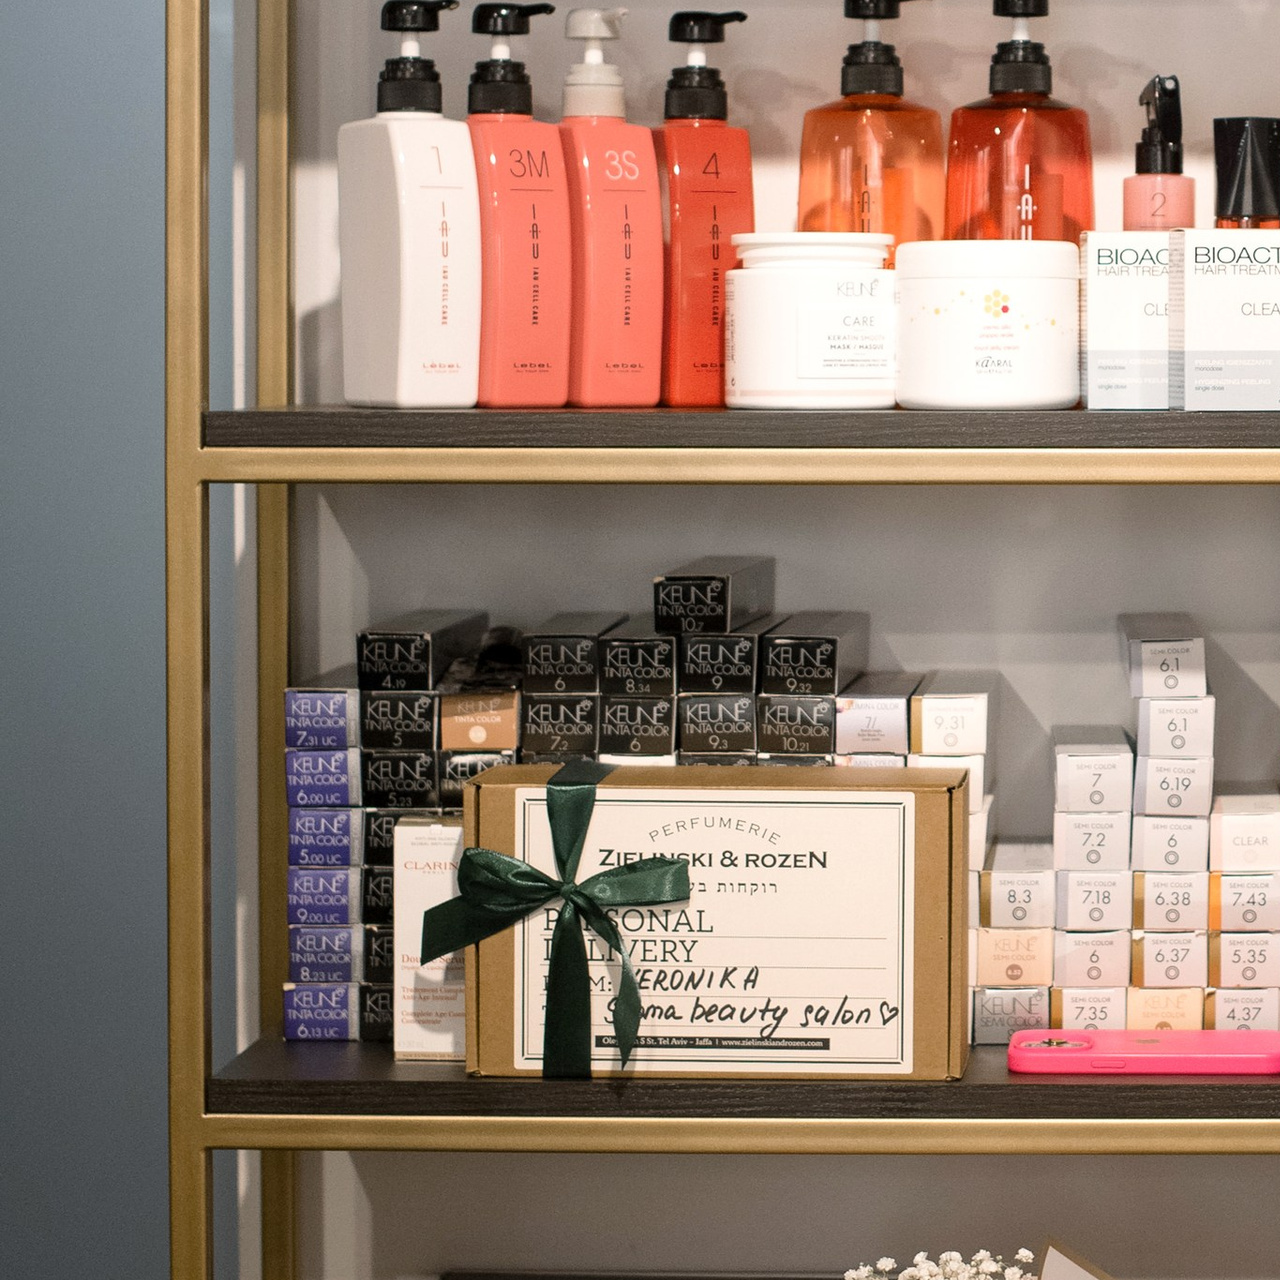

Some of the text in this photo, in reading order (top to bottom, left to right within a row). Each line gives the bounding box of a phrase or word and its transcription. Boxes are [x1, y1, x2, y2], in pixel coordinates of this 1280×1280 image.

[430, 145, 443, 175] 1
[509, 148, 549, 179] 3M
[605, 150, 640, 180] 3S
[702, 152, 721, 180] 4
[1151, 192, 1166, 217] 2
[1097, 249, 1169, 265] BIOAC
[1097, 266, 1130, 276] HAIR
[1194, 265, 1227, 275] HAIR
[836, 279, 880, 298] KEUNE
[843, 315, 875, 327] CARE
[660, 580, 723, 605] KEUNE
[658, 604, 724, 617] TINTA COLOR
[768, 642, 832, 667] KEUNE
[766, 666, 833, 679] TINTA COLOR
[1160, 658, 1180, 673] 6.1
[786, 679, 812, 693] 9.32
[291, 695, 344, 716] KEUNE
[286, 716, 347, 728] TINTA COLOR
[296, 731, 337, 746] 7.31 UC
[1160, 777, 1192, 792] 6.19
[649, 816, 781, 845] PERFUMERIE
[1233, 836, 1268, 847] CLEAR
[403, 860, 459, 870] CLARIN
[720, 850, 738, 868] &
[1082, 890, 1111, 905] 7.18
[1155, 892, 1191, 906] 6.38
[1232, 892, 1267, 907] 7.43
[544, 908, 714, 933] PSONAL
[544, 938, 698, 963] LIVERY
[691, 997, 788, 1039] beauty
[799, 995, 871, 1028] salon
[658, 1037, 670, 1045] Tel
[671, 1037, 688, 1046] Aviv
[695, 1038, 713, 1046] Jaffa
[722, 1038, 824, 1048] www.zielinskiandrozen.com
